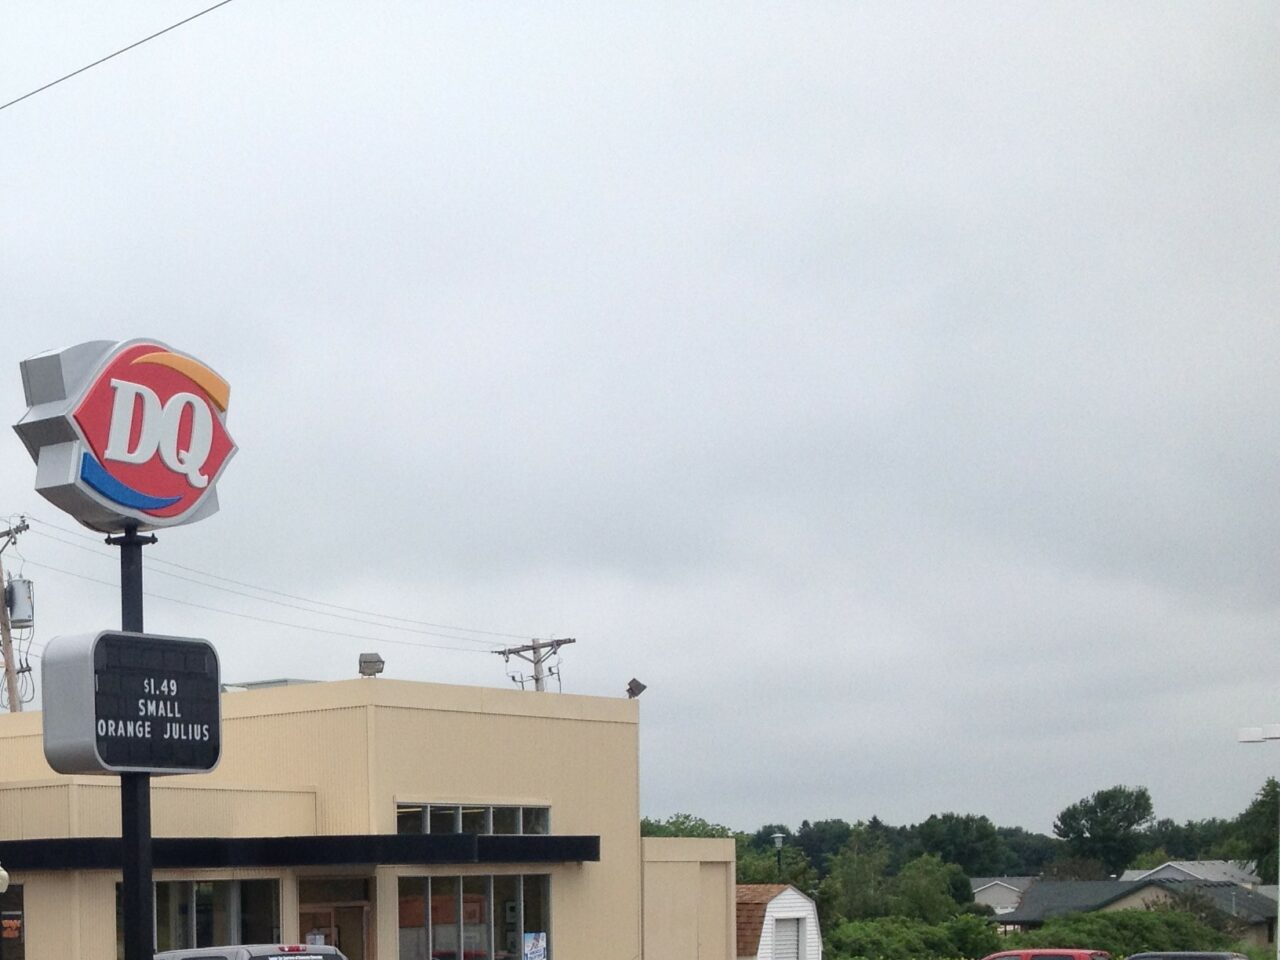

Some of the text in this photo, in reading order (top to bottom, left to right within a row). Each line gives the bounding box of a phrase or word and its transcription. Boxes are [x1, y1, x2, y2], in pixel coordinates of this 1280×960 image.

[104, 378, 214, 488] DQ
[144, 678, 178, 696] $1.49
[138, 699, 181, 718] SMALL
[97, 719, 210, 742] ORANGE JULIUS
